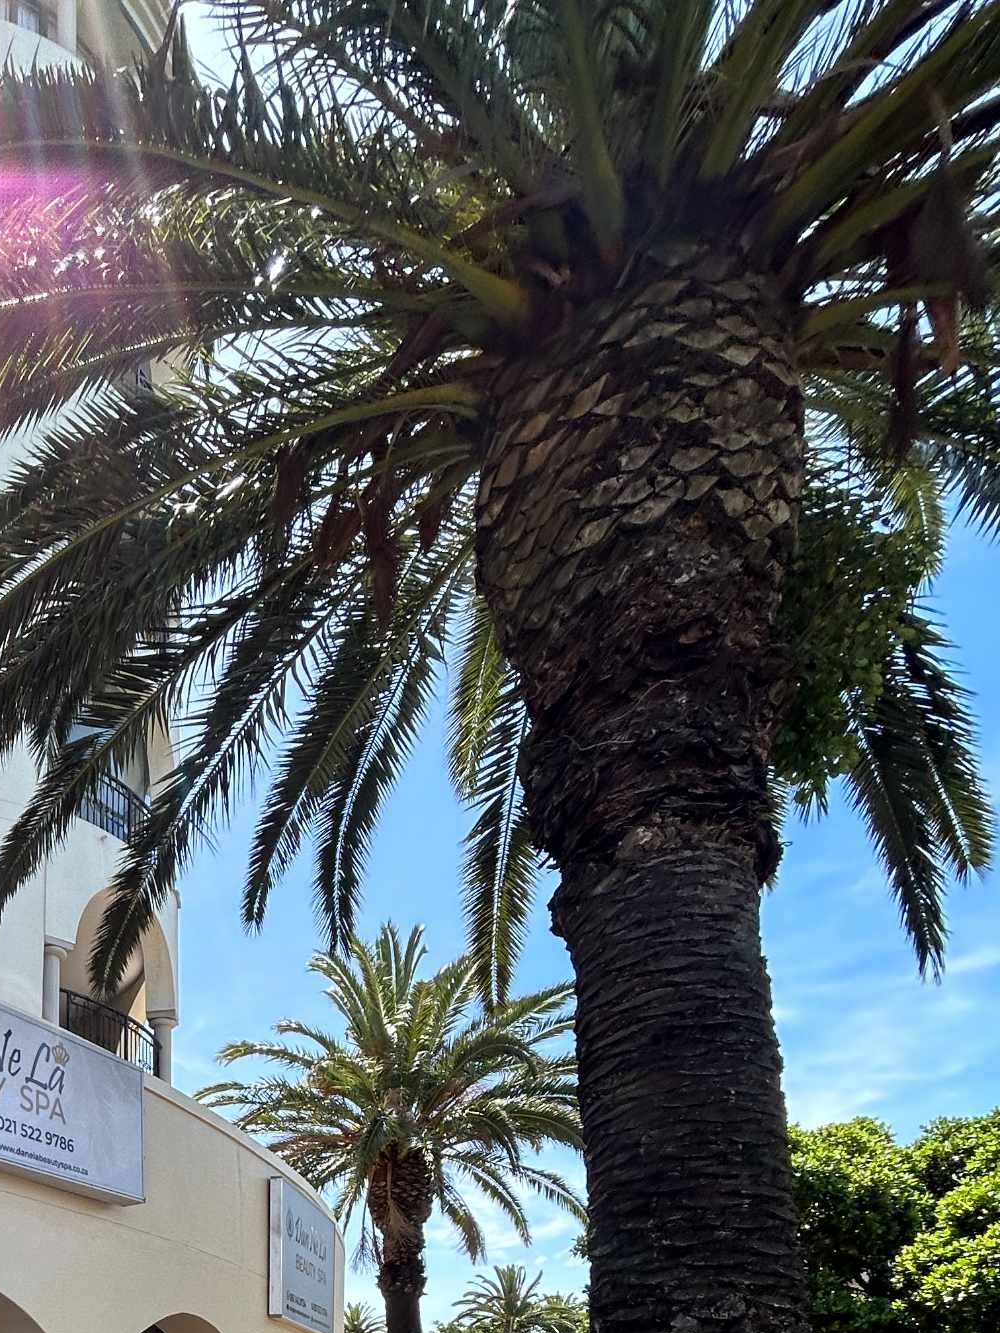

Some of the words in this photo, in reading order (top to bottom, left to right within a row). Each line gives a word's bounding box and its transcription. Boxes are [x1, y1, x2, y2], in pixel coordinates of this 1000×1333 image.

[25, 1043, 65, 1095] La
[20, 1085, 67, 1125] SPA
[20, 1123, 43, 1144] 522
[45, 1131, 75, 1153] 9786
